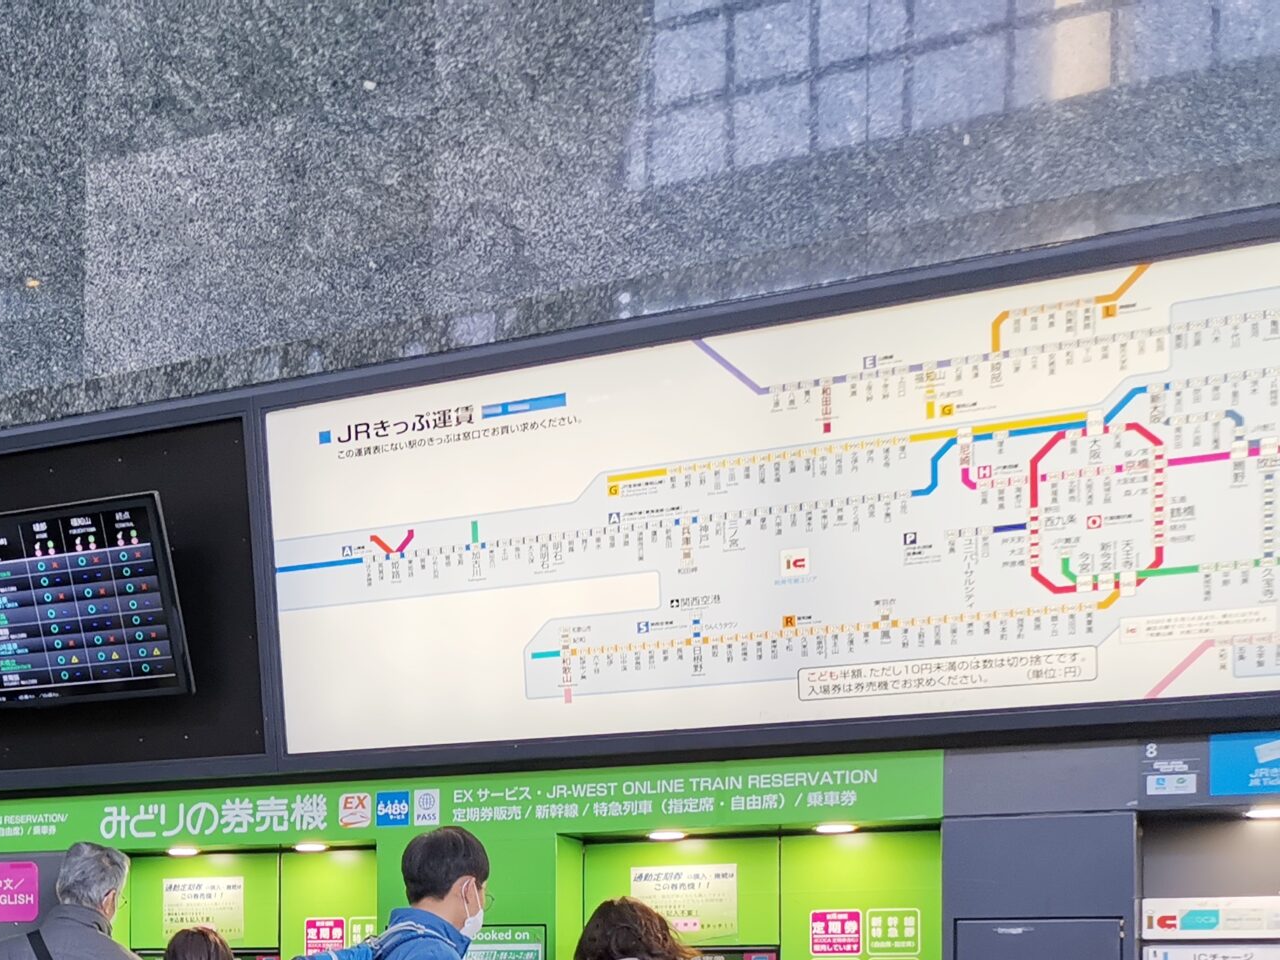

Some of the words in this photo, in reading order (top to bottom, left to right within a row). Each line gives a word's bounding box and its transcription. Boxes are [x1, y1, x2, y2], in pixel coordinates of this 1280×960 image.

[337, 404, 475, 444] JRきっぷ運賃
[1089, 439, 1101, 460] 大阪
[1044, 514, 1077, 528] 西九条
[1122, 540, 1133, 569] 天王寺
[562, 657, 571, 683] 和歌山
[1145, 743, 1157, 757] 8
[453, 788, 474, 802] EX
[623, 777, 684, 796] ONLINE
[689, 775, 743, 792] TRAIN
[748, 768, 878, 788] RESERVATION
[343, 795, 367, 811] EX
[377, 802, 409, 817] 5489
[99, 793, 328, 839] みどりの券売機
[416, 812, 437, 822] PASS
[514, 932, 530, 940] on
[812, 921, 858, 935] 定期券
